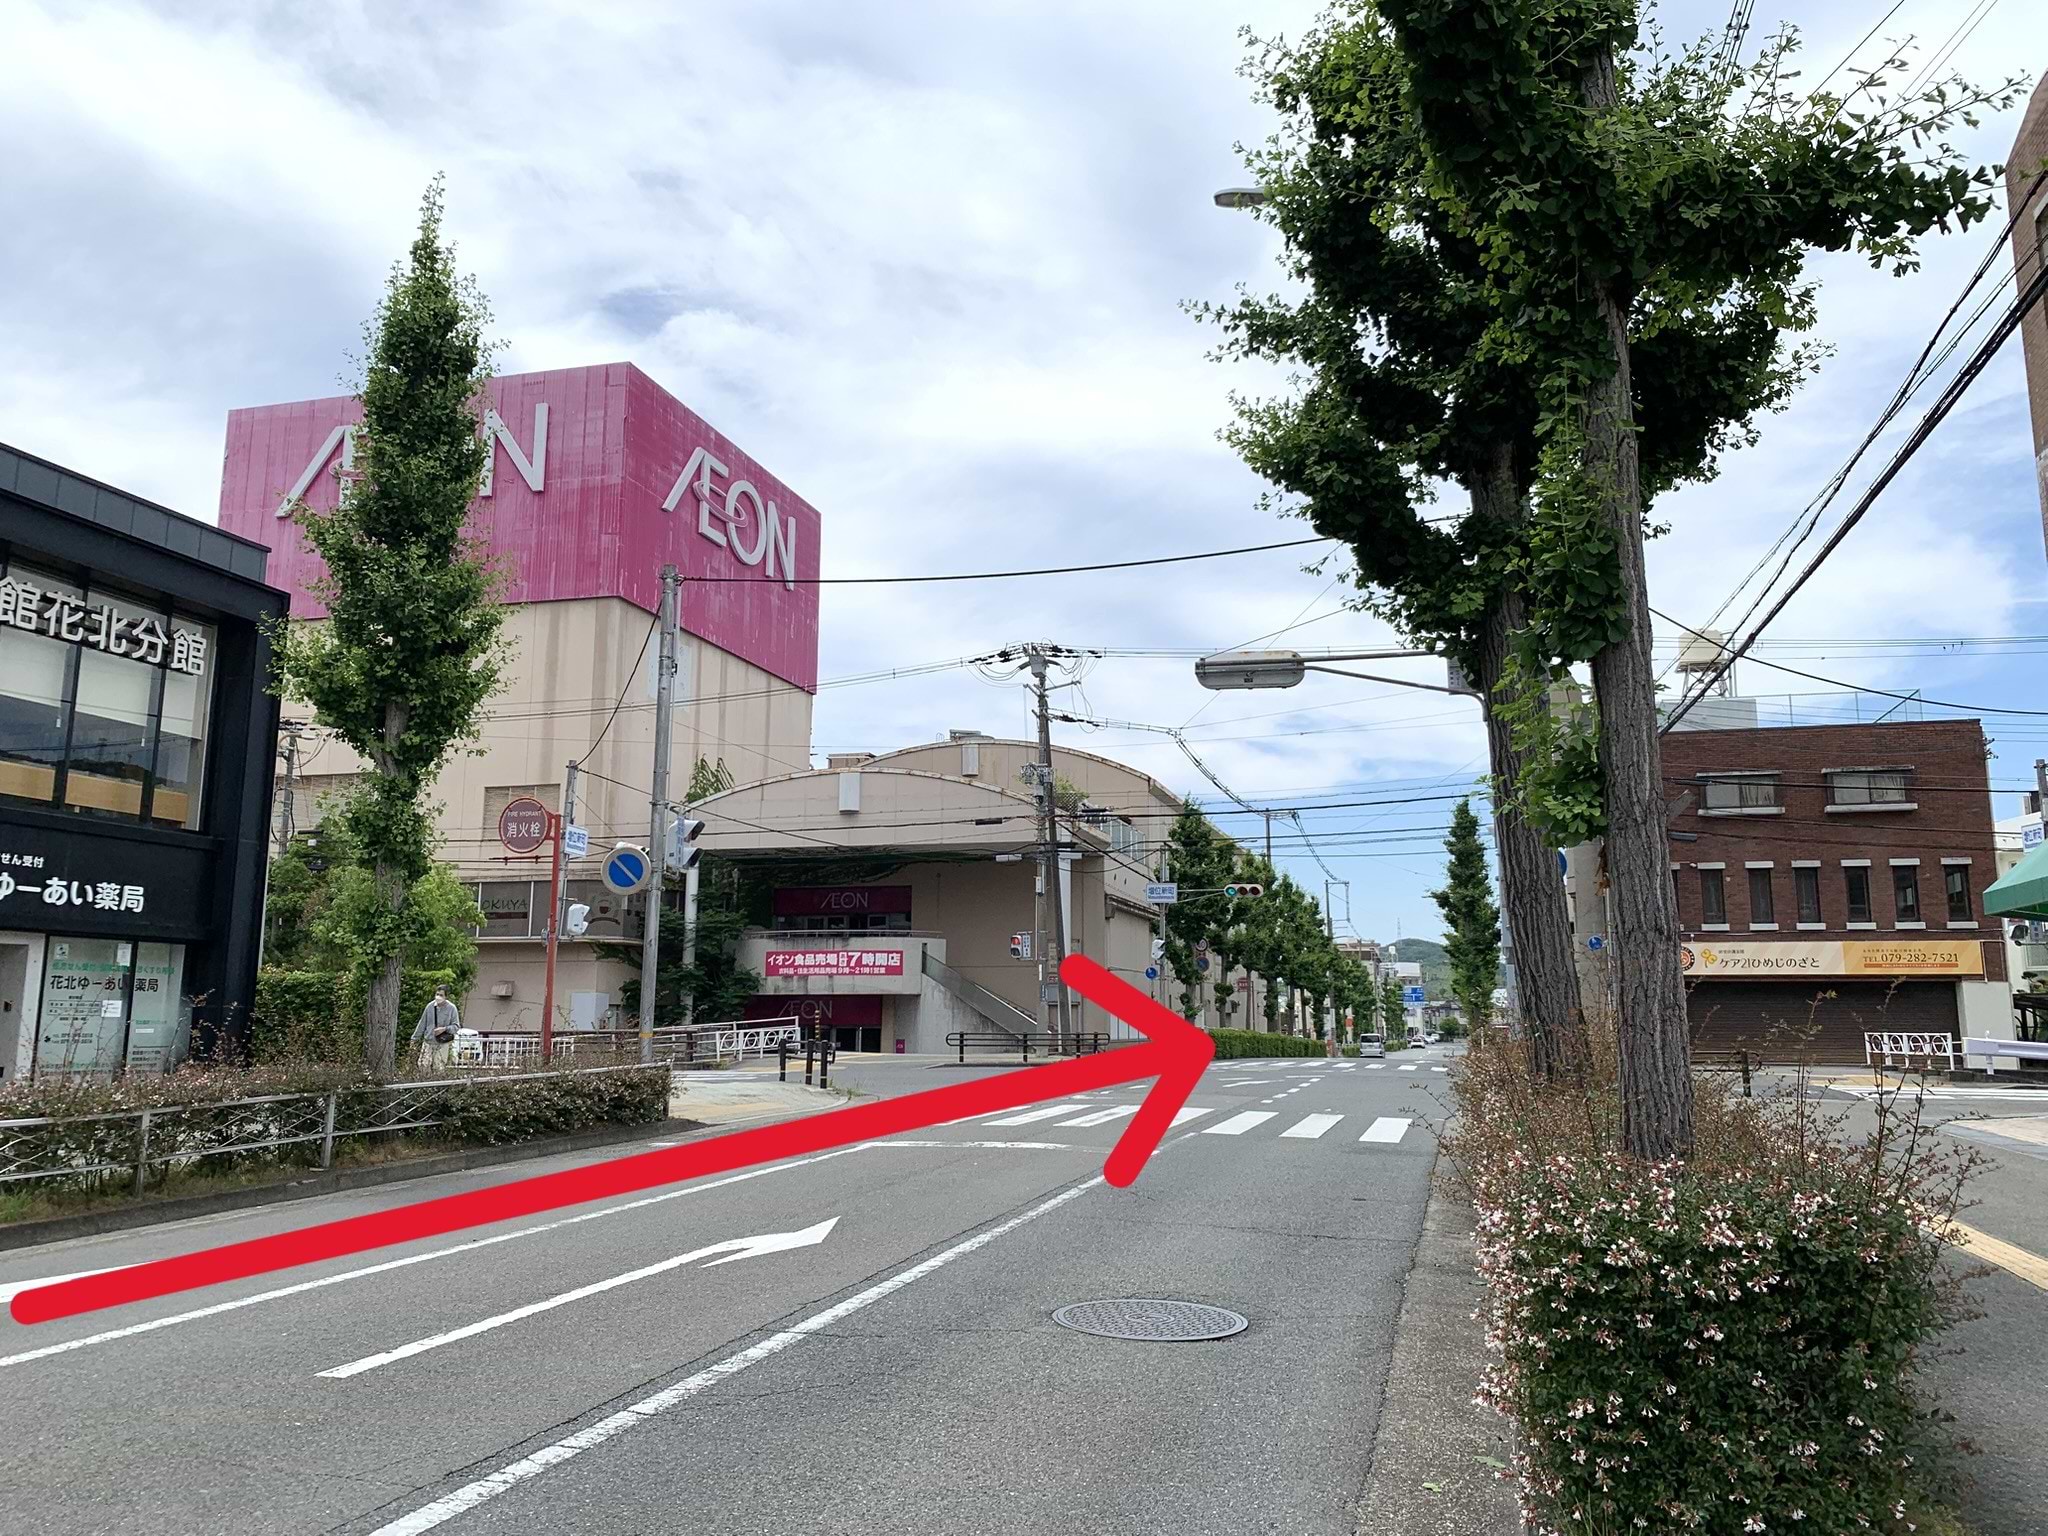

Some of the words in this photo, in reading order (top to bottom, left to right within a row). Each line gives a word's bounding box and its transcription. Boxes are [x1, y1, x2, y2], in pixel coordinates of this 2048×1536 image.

[0, 576, 207, 676] 館花北分館
[506, 821, 541, 838] 消火栓
